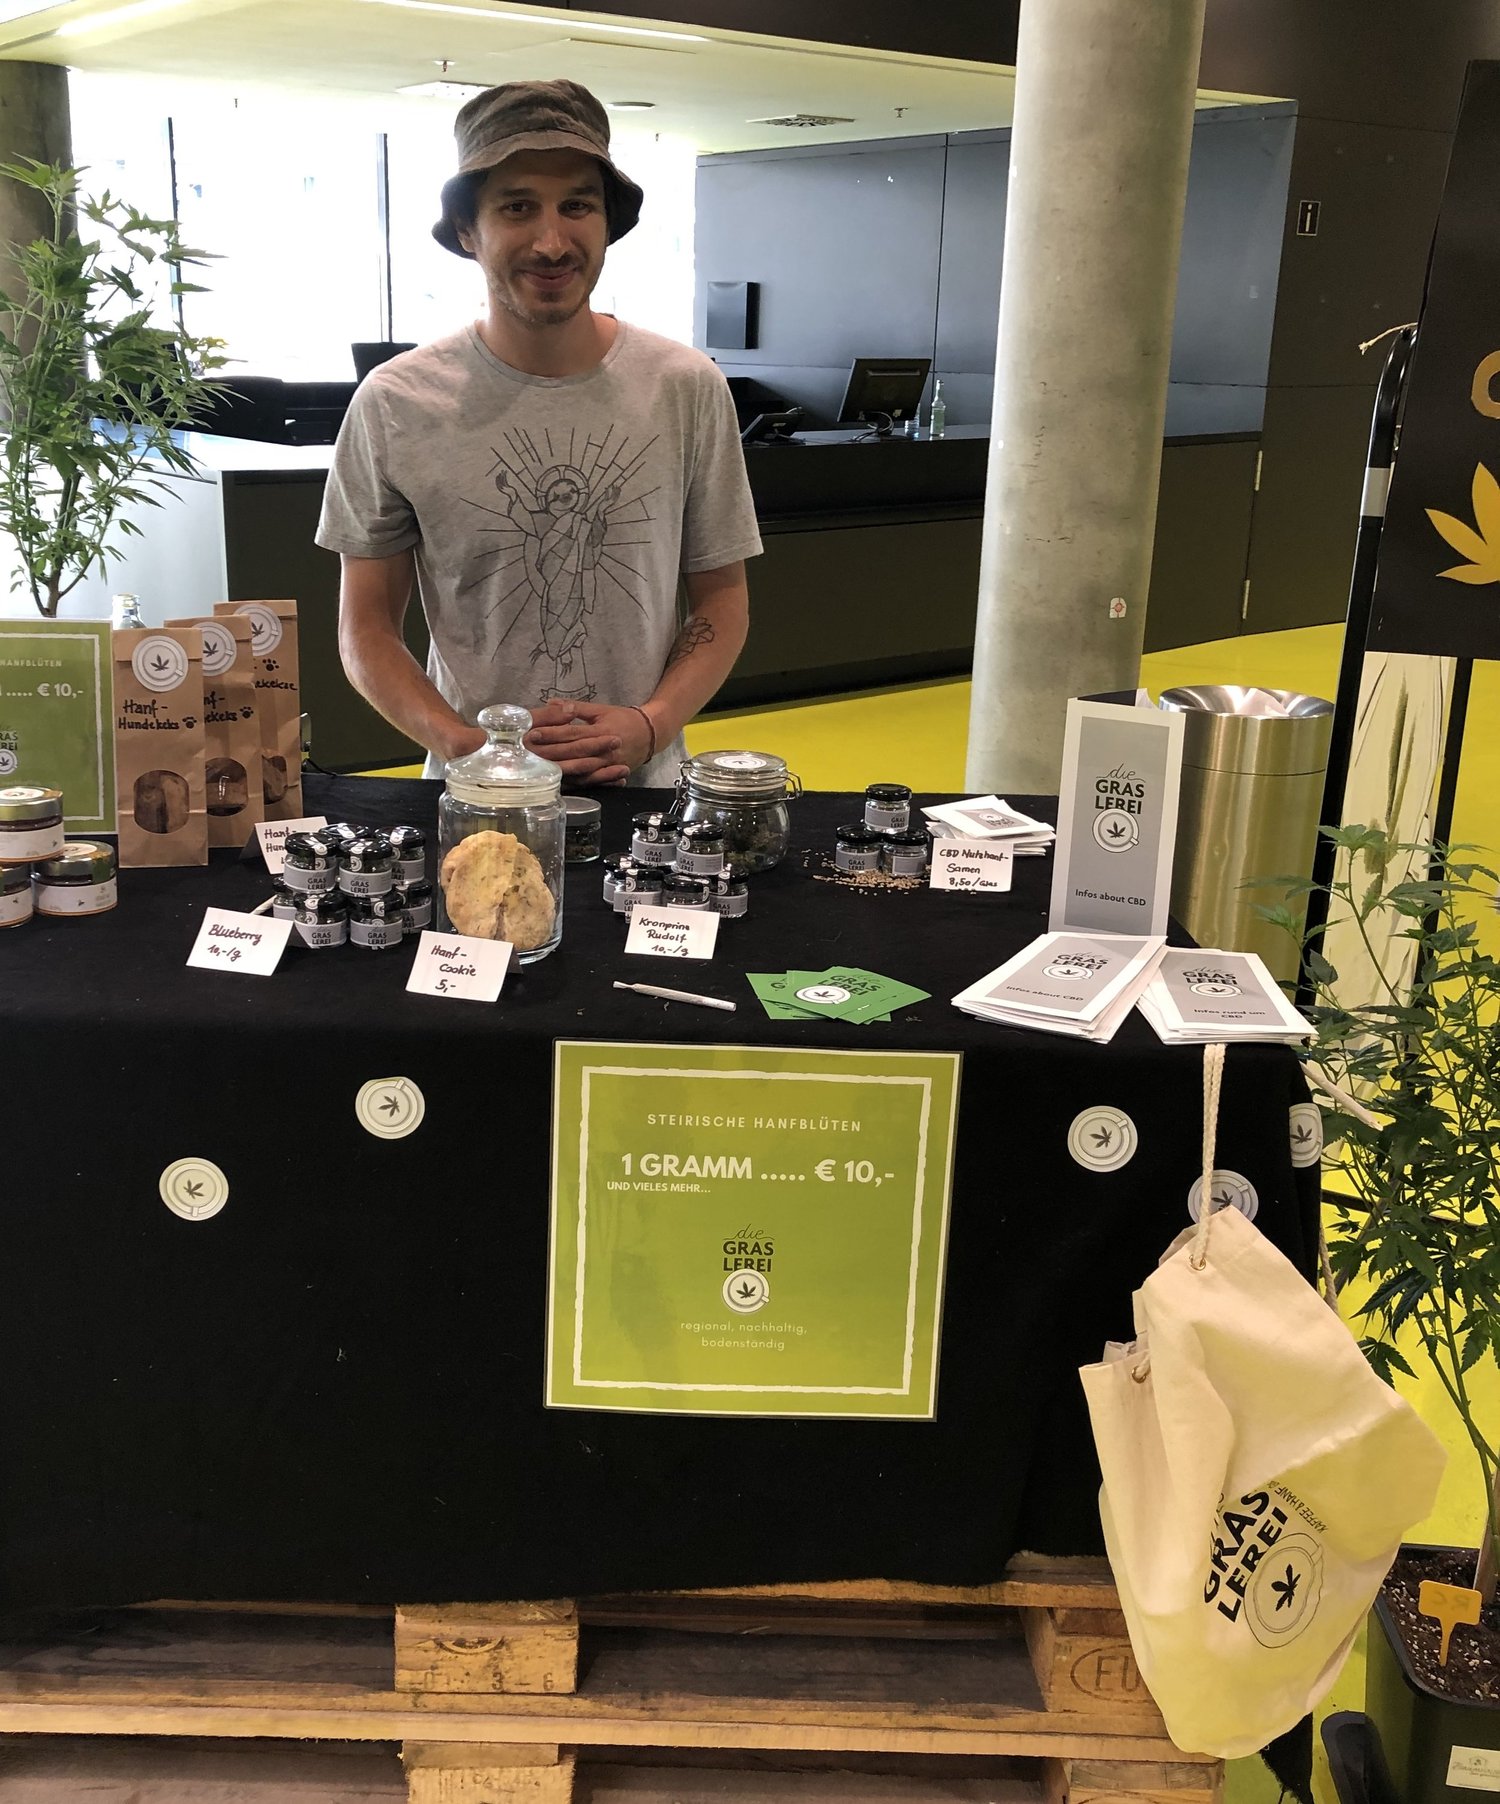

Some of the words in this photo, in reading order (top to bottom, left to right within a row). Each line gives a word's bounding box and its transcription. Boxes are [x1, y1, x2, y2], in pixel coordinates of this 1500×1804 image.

[37, 683, 50, 697] €
[54, 683, 84, 698] 10,-
[122, 699, 169, 718] Hanf-
[204, 711, 238, 724] ekeks
[1096, 763, 1146, 783] die
[1095, 779, 1145, 798] GRAS
[1094, 796, 1142, 814] LEREI
[940, 848, 960, 858] CBD
[946, 863, 980, 874] Samen
[350, 880, 370, 888] GRAS
[1075, 888, 1098, 899] Infos
[1100, 892, 1125, 903] about
[1127, 896, 1146, 906] CBD
[208, 924, 262, 946] Blueberry
[646, 928, 688, 943] Rudolf
[430, 945, 468, 959] Hanf-
[1057, 954, 1109, 964] GRAS
[440, 964, 476, 976] Cookie
[1052, 960, 1103, 970] LEREI
[1182, 972, 1237, 980] GRAS
[435, 979, 456, 993] 5,-
[817, 980, 869, 996] LEREI
[830, 976, 881, 992] GRAS
[1032, 990, 1061, 998] about
[648, 1114, 745, 1128] STEIRISCHE
[754, 1116, 862, 1132] HANFBLÜTEN
[621, 1152, 632, 1176] 1
[640, 1153, 752, 1180] GRAMM
[814, 1158, 836, 1182] €
[844, 1160, 895, 1188] 10,-
[606, 1181, 630, 1191] UND
[633, 1182, 668, 1192] VIELES
[670, 1182, 712, 1192] MEHR...
[723, 1223, 775, 1240] die
[723, 1240, 774, 1256] GRAS
[723, 1258, 772, 1272] LEREI
[680, 1321, 735, 1332] regional,
[739, 1322, 808, 1336] nachhaltig,
[1274, 1486, 1300, 1508] HANF
[1299, 1508, 1328, 1534] KAFFEE
[1204, 1492, 1270, 1604] GRAS
[1217, 1506, 1288, 1623] LEREI
